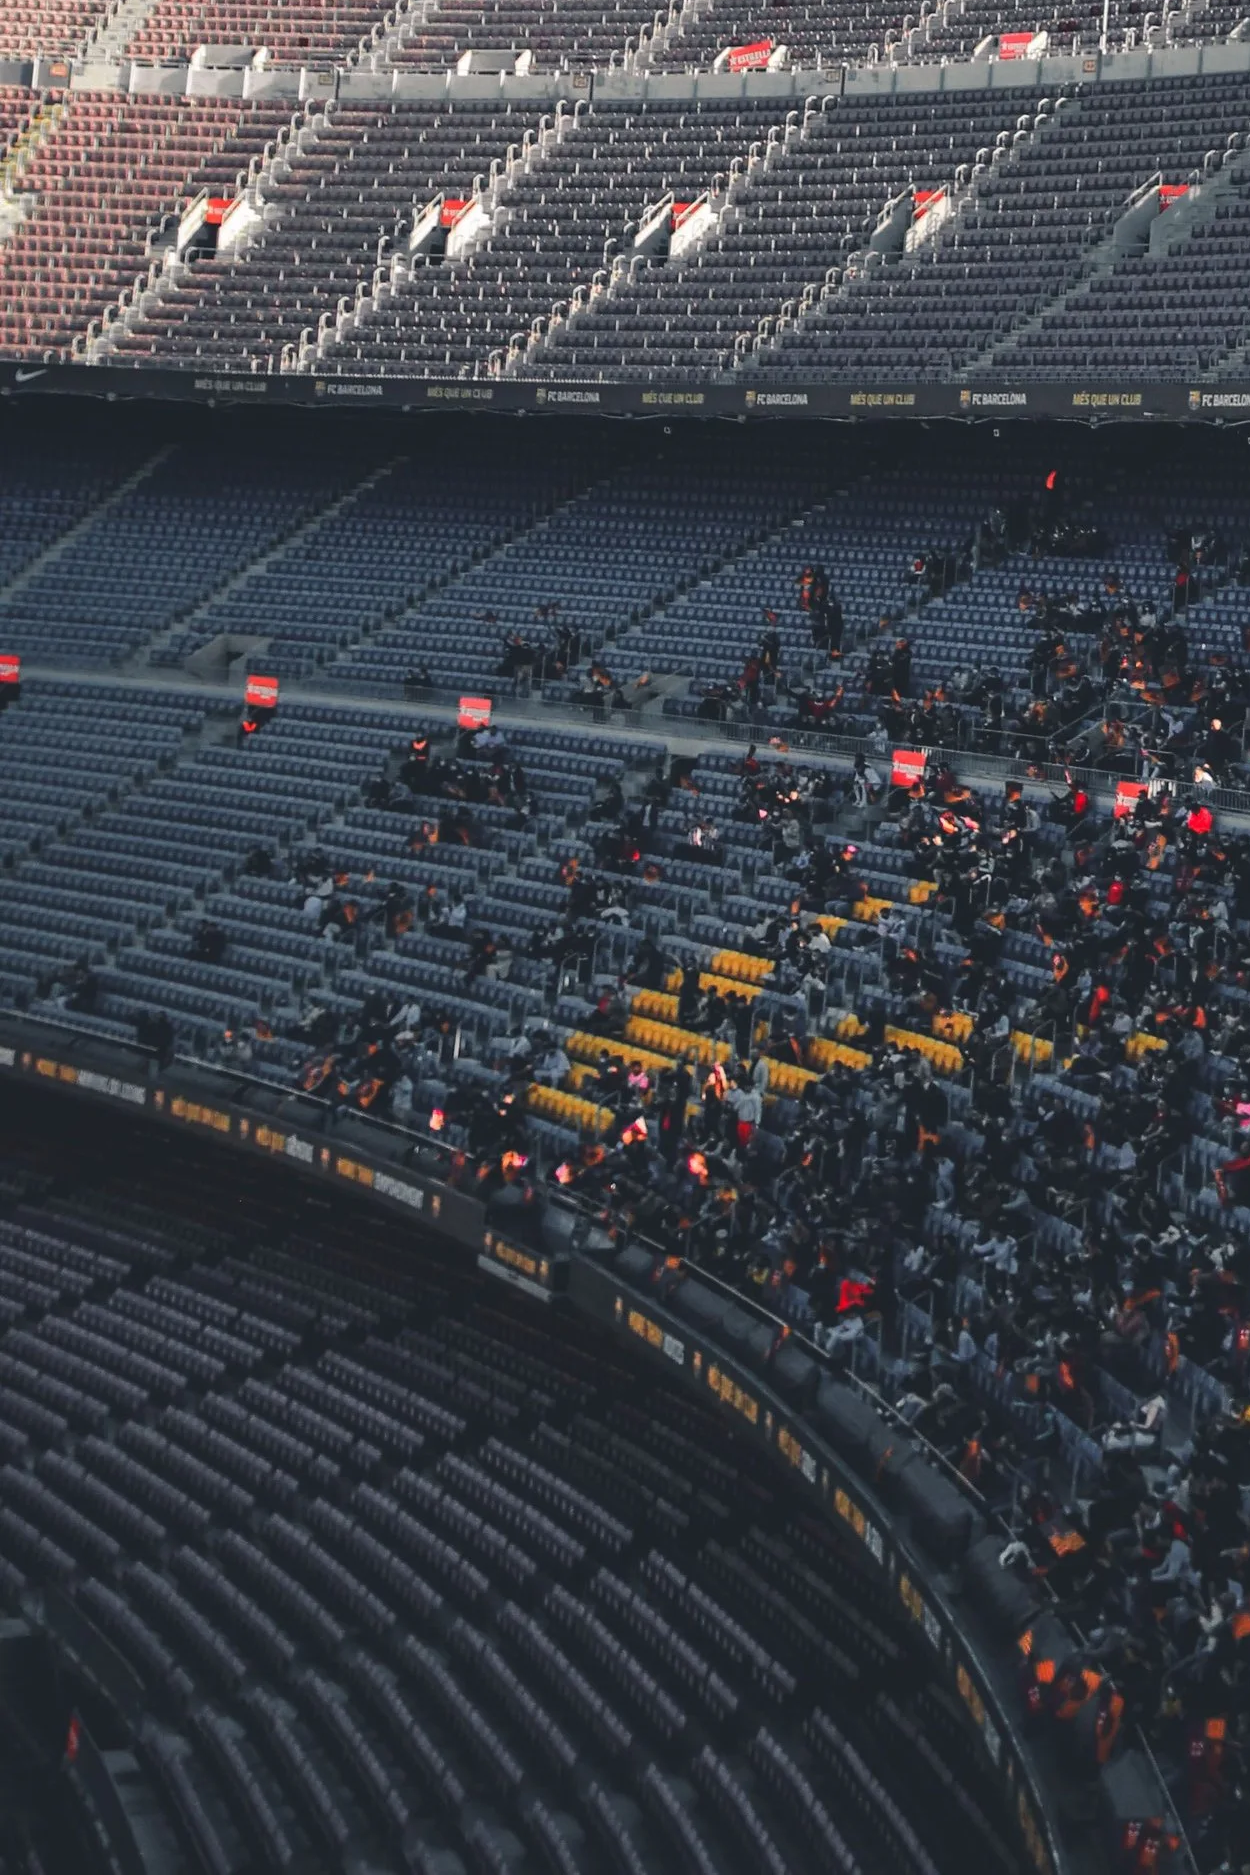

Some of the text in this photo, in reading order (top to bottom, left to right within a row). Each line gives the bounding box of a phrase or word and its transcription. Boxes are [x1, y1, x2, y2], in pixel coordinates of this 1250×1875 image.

[757, 393, 808, 405] FC BARCELONA
[972, 393, 1026, 405] FC BARCELONA
[1090, 393, 1107, 407] QUE
[1108, 393, 1120, 405] UN
[1121, 393, 1141, 405] CLUB
[1202, 394, 1212, 407] FC
